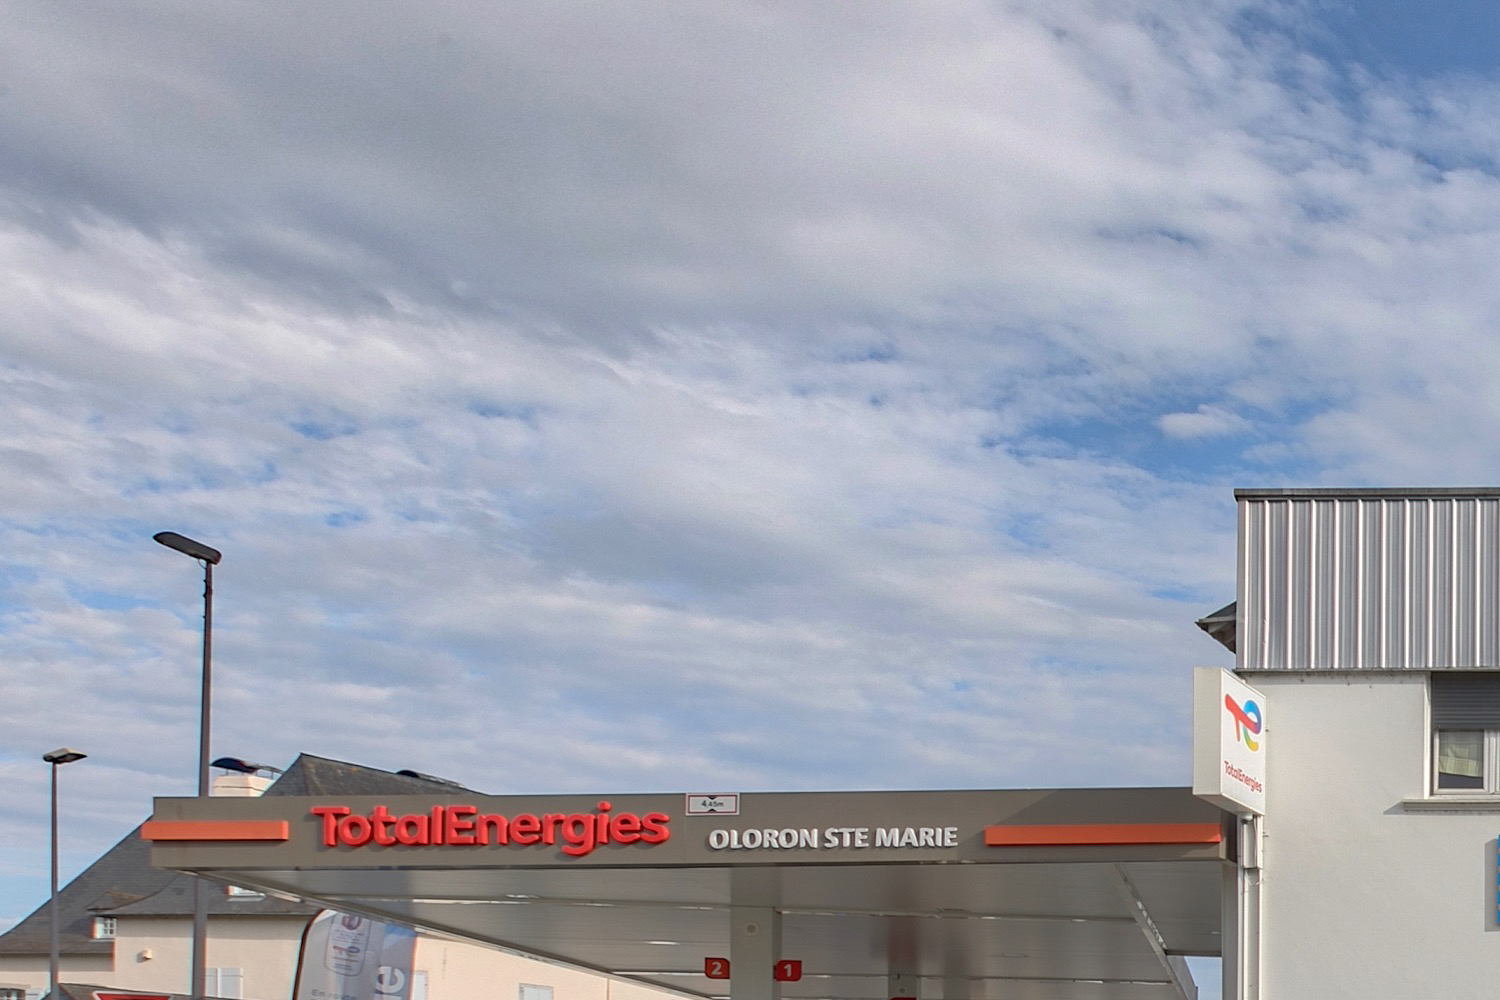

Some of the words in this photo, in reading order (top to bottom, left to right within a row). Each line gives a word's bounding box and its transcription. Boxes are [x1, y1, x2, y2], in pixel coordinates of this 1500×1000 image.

[1223, 760, 1263, 793] TotalEnergies
[310, 801, 671, 856] TotalEnergies
[708, 828, 818, 850] OLORON
[824, 827, 869, 849] STE
[875, 826, 958, 848] MARIE
[711, 961, 722, 975] 2
[783, 964, 792, 977] 1
[311, 988, 326, 998] En
